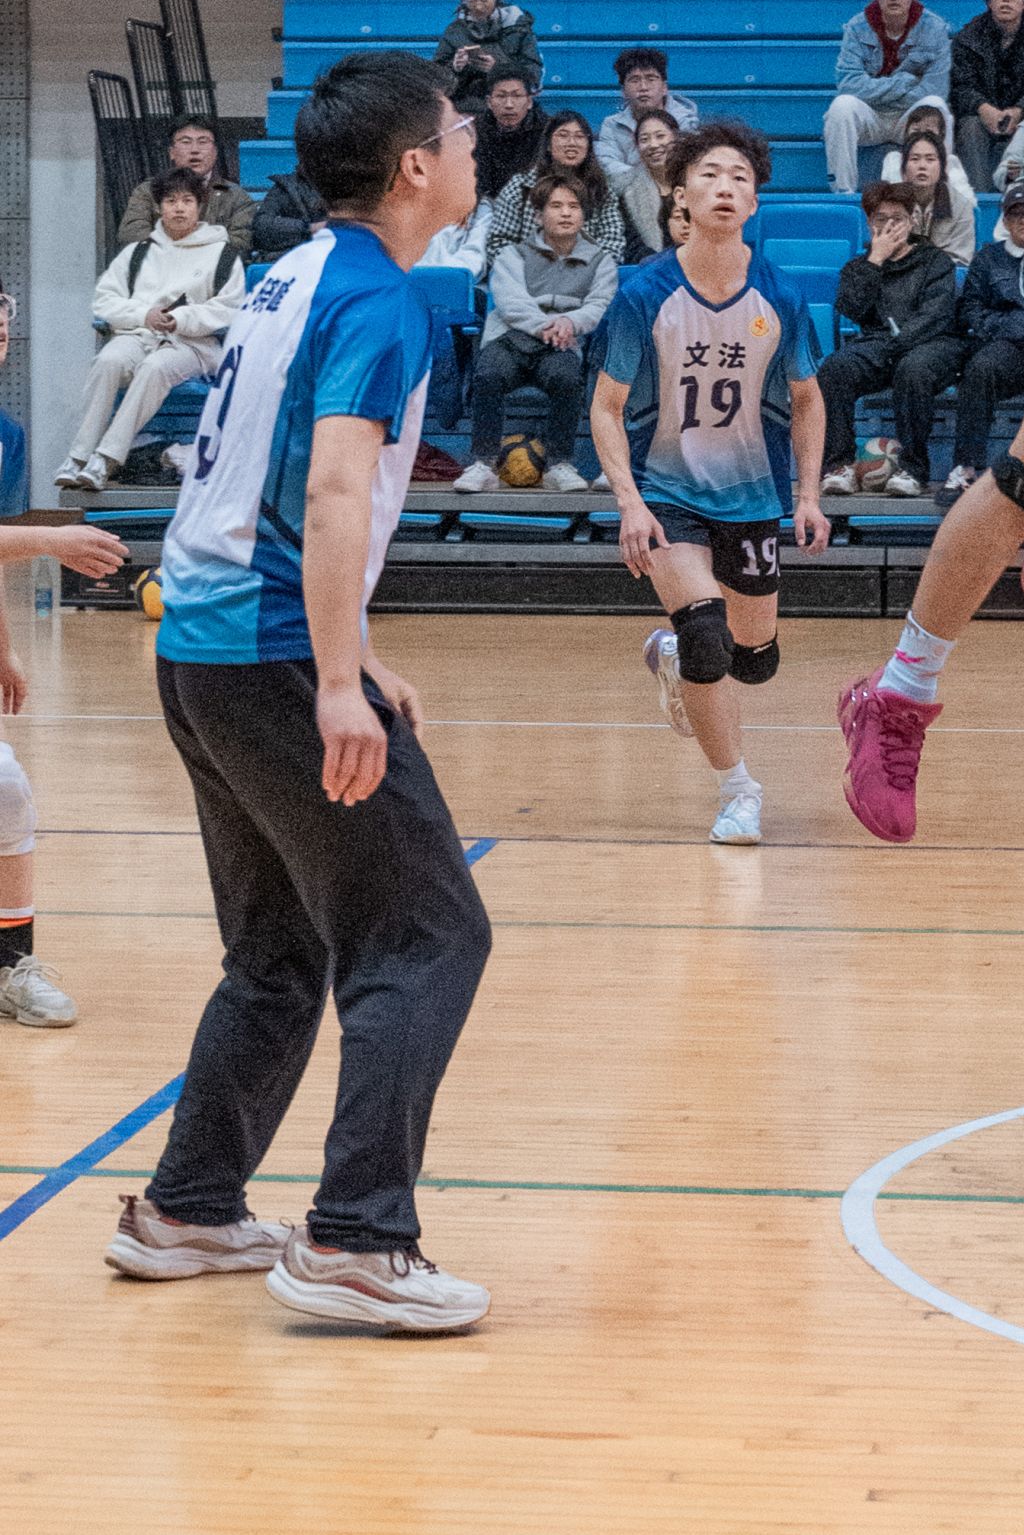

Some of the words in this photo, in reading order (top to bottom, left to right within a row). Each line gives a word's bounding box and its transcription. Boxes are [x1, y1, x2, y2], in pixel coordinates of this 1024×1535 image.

[683, 341, 747, 369] 文法
[679, 375, 743, 433] 19
[740, 537, 780, 578] 19
